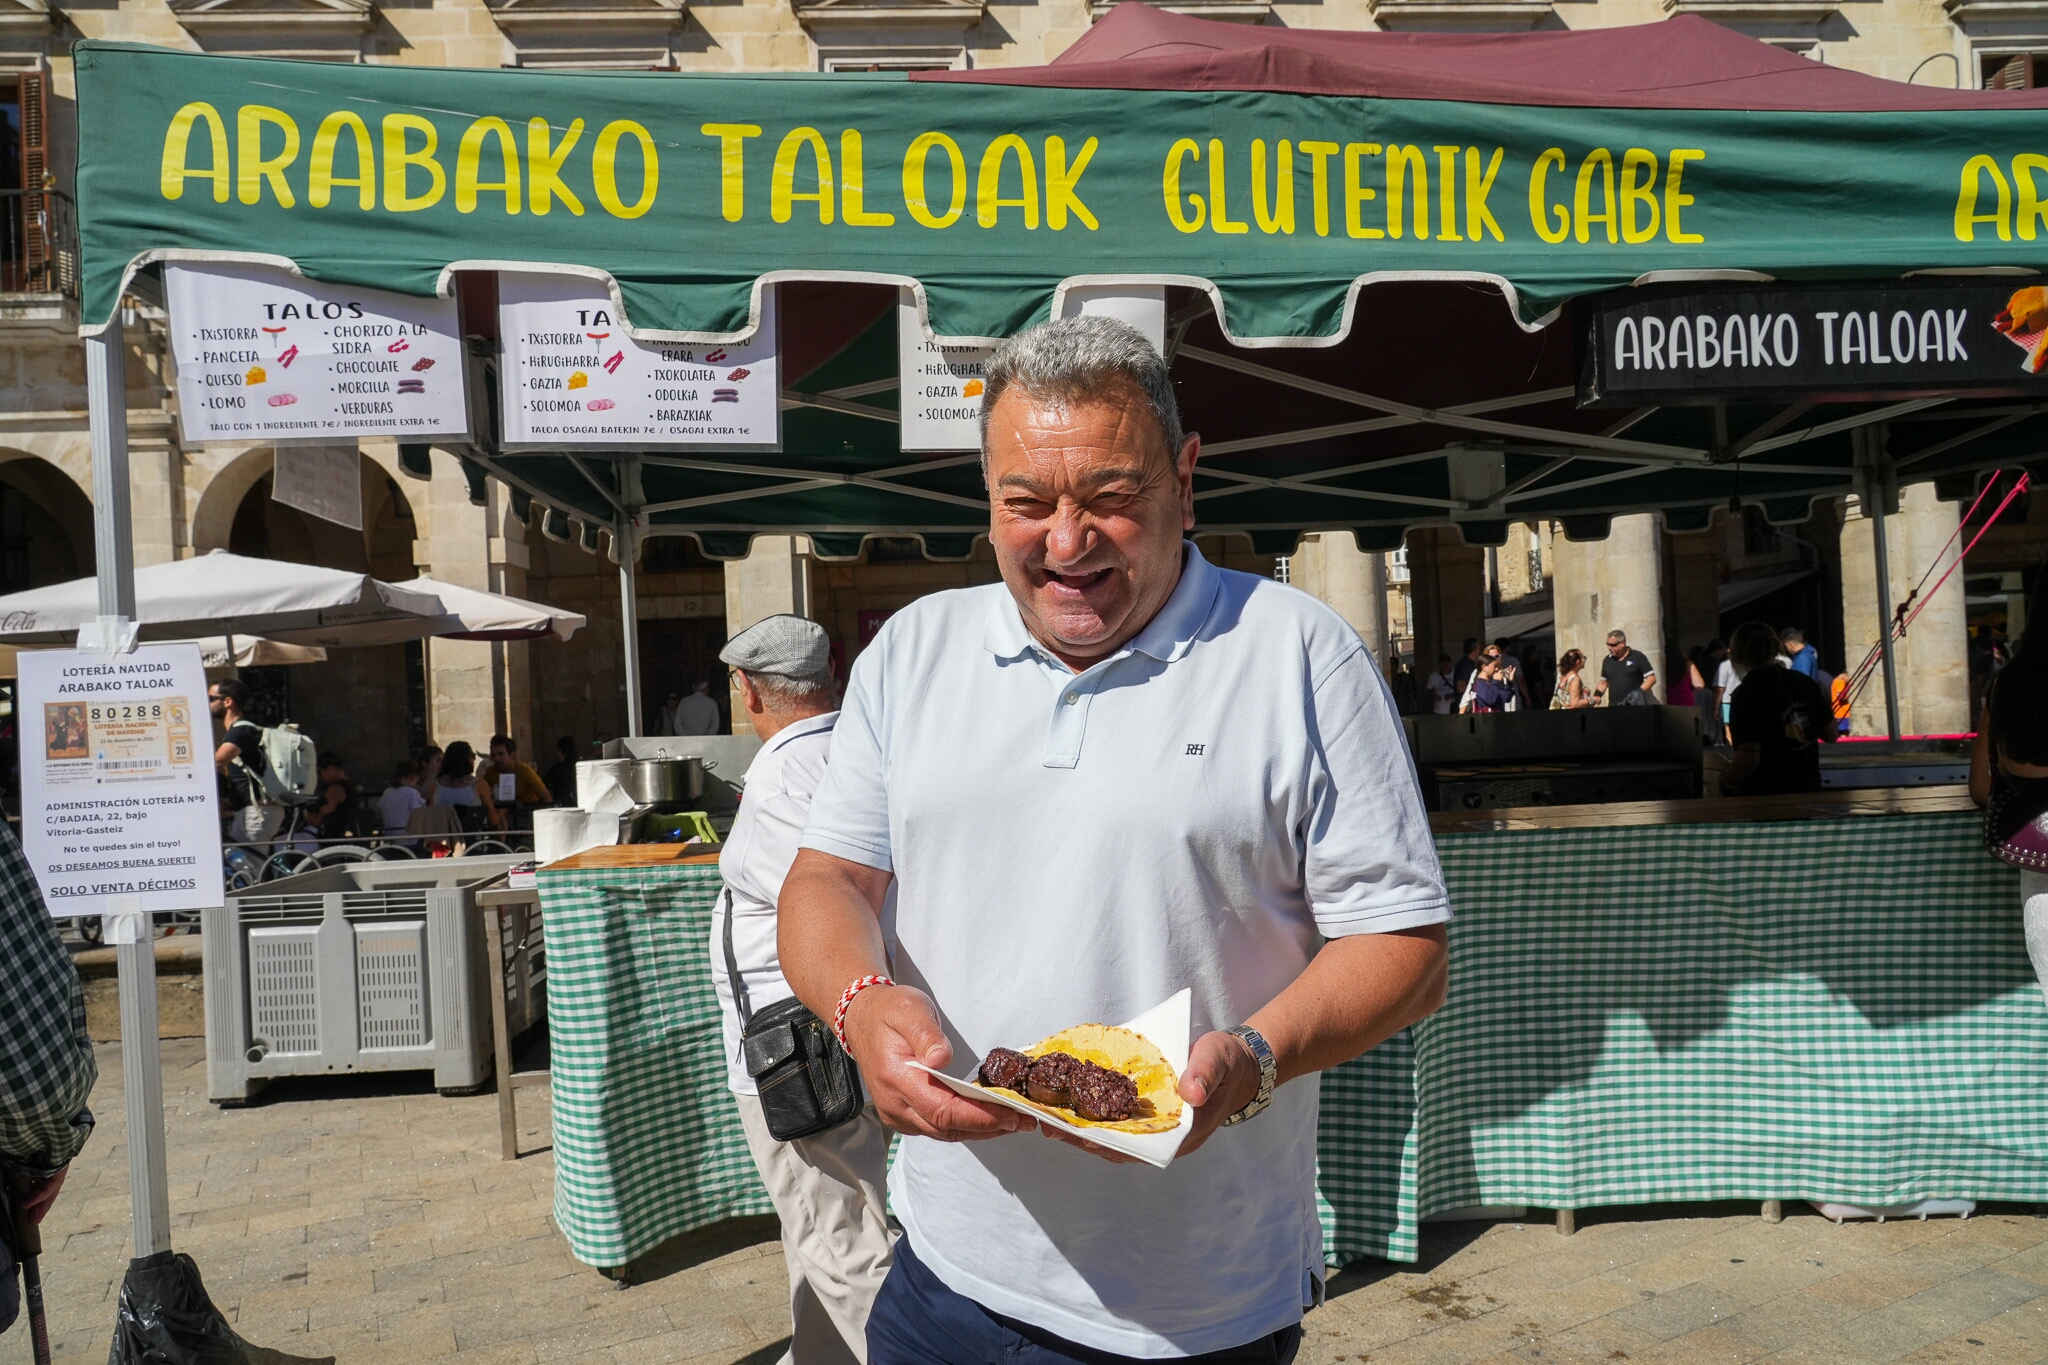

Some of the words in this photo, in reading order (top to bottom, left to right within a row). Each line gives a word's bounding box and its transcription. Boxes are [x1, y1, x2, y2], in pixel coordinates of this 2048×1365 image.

[161, 101, 659, 219] ARABAKO
[701, 122, 1099, 231] TALOAK
[1163, 137, 1505, 243] GLUTENIK
[1529, 147, 1705, 244] GABE
[263, 302, 363, 320] TALOS
[334, 325, 393, 338] CHORIZO
[398, 325, 408, 336] A
[412, 324, 428, 336] LA
[1614, 313, 1799, 371] ARABAKO
[1815, 308, 1968, 365] TALOAK
[332, 343, 372, 355] SIDRA
[203, 351, 260, 363] PANCETA
[662, 350, 694, 362] ERARA
[336, 361, 400, 374] CHOCOLATE
[206, 373, 242, 387] QUESO
[654, 369, 716, 381] TXOKOLATEA
[338, 381, 390, 394] MORCILLA
[530, 378, 562, 390] GAZTA
[926, 386, 958, 398] GAZTA
[209, 396, 246, 409] LOMO
[341, 402, 394, 414] VERDURAS
[531, 400, 581, 412] SOLOMOA
[657, 409, 712, 422] BARAZKIAK
[926, 408, 976, 420] SOLOMOA
[210, 423, 231, 431] TALO
[233, 422, 252, 430] CON
[255, 422, 260, 430] 1
[264, 421, 319, 430] INGREDIENTE
[344, 419, 398, 428] INGREDIENTE
[400, 418, 425, 426] EXTRA
[427, 418, 440, 426] 1€
[531, 426, 559, 434] TALOA
[563, 426, 598, 434] OSAGAI
[601, 426, 640, 434] BATEKIN
[643, 426, 656, 434] 7€
[670, 426, 704, 435] OSAGAI
[708, 426, 735, 435] EXTRA
[737, 426, 750, 435] 1€
[63, 664, 116, 677] LOTERÍA
[119, 663, 171, 675] NAVIDAD
[58, 681, 122, 693] ARABAKO
[126, 678, 174, 690] TALOAK
[176, 746, 187, 755] 20
[46, 797, 140, 811] ADMINISTRACIÓN
[143, 794, 185, 806] LOTERÍA
[46, 813, 103, 825] C/BADAIA,
[107, 813, 122, 821] 22,
[126, 811, 147, 821] bajo
[46, 826, 123, 837] Vitoria-Gasteiz
[63, 846, 77, 854] No
[92, 843, 127, 853] quedes
[130, 842, 144, 850] sin
[157, 840, 181, 850] tuyo!
[48, 864, 63, 873] OS
[65, 860, 120, 871] DESEAMOS
[123, 858, 155, 868] BUENA
[157, 856, 196, 866] SUERTE!
[50, 886, 87, 897] SOLO
[91, 882, 135, 894] VENTA
[138, 878, 196, 891] DÉCIMOS
